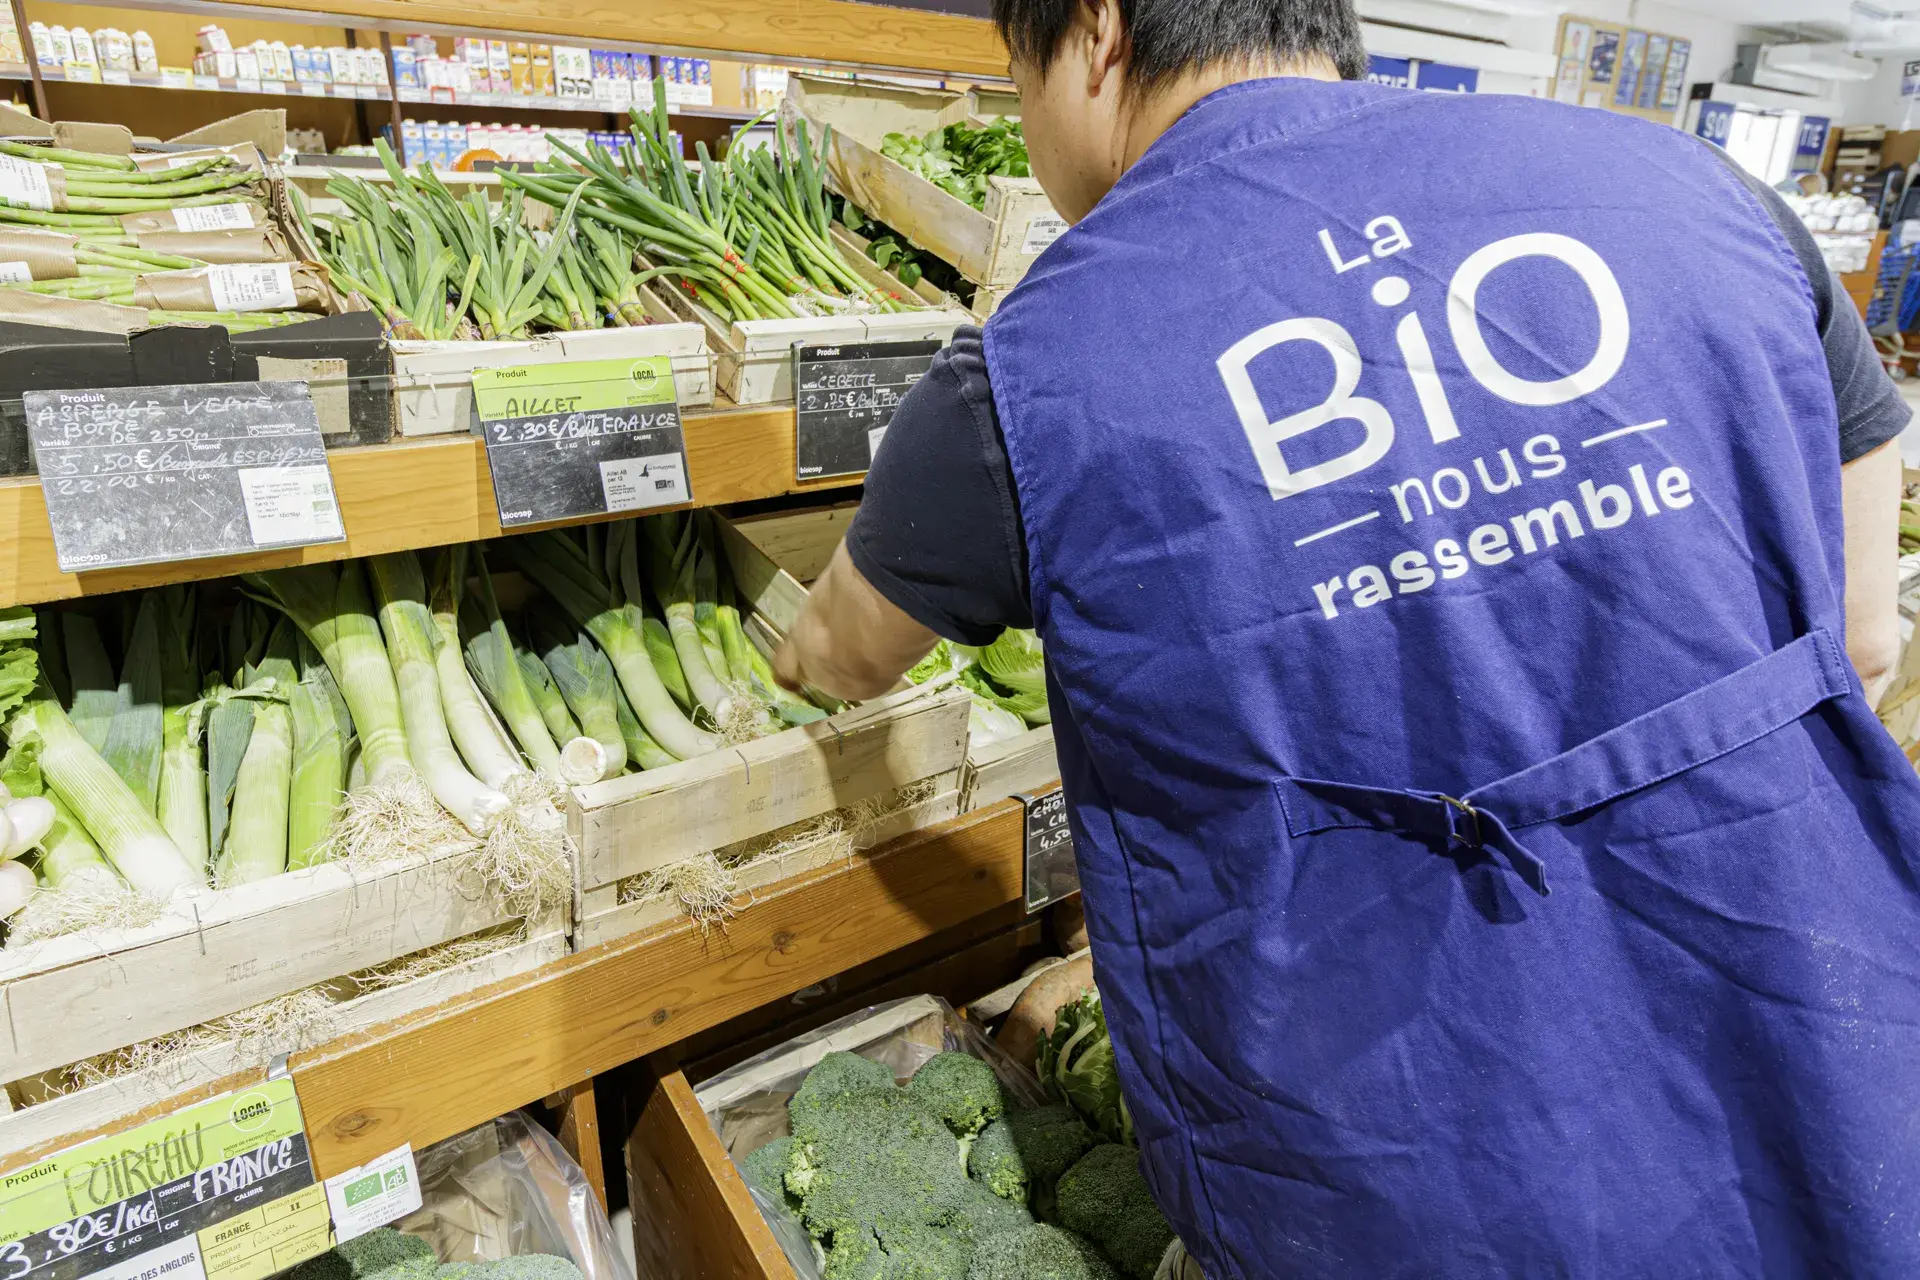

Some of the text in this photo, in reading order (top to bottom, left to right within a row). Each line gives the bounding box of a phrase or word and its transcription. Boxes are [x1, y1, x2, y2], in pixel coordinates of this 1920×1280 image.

[1318, 215, 1412, 274] La
[816, 348, 840, 356] Produit
[496, 369, 527, 379] Produit
[632, 369, 656, 380] LOCAL
[1215, 232, 1630, 501] BiO
[60, 393, 106, 404] Produit
[505, 396, 582, 419] AILLET
[64, 420, 140, 438] BOTTE
[40, 440, 71, 448] Variété
[192, 443, 221, 451] ORIGINE
[1388, 434, 1567, 524] nous
[501, 510, 532, 519] biocoop
[1312, 464, 1695, 620] rassemble
[62, 553, 107, 564] biocoop
[1049, 813, 1067, 827] CH
[233, 1100, 271, 1123] LOCAL
[223, 1143, 238, 1151] MODE
[246, 1129, 276, 1144] PRODUCTION
[5, 1163, 58, 1188] Produit
[63, 1121, 204, 1216] POIREAU
[192, 1136, 292, 1202] FRANCE
[158, 1181, 191, 1198] ORIGINE
[387, 1171, 405, 1191] AB
[234, 1186, 264, 1202] CALIBRE
[164, 1220, 179, 1231] CAT
[215, 1222, 251, 1243] FRANCE
[0, 1231, 18, 1243] iété
[105, 1240, 117, 1253] €
[210, 1243, 242, 1260] PRODUIT
[140, 1252, 196, 1280] DES ANGLOIS
